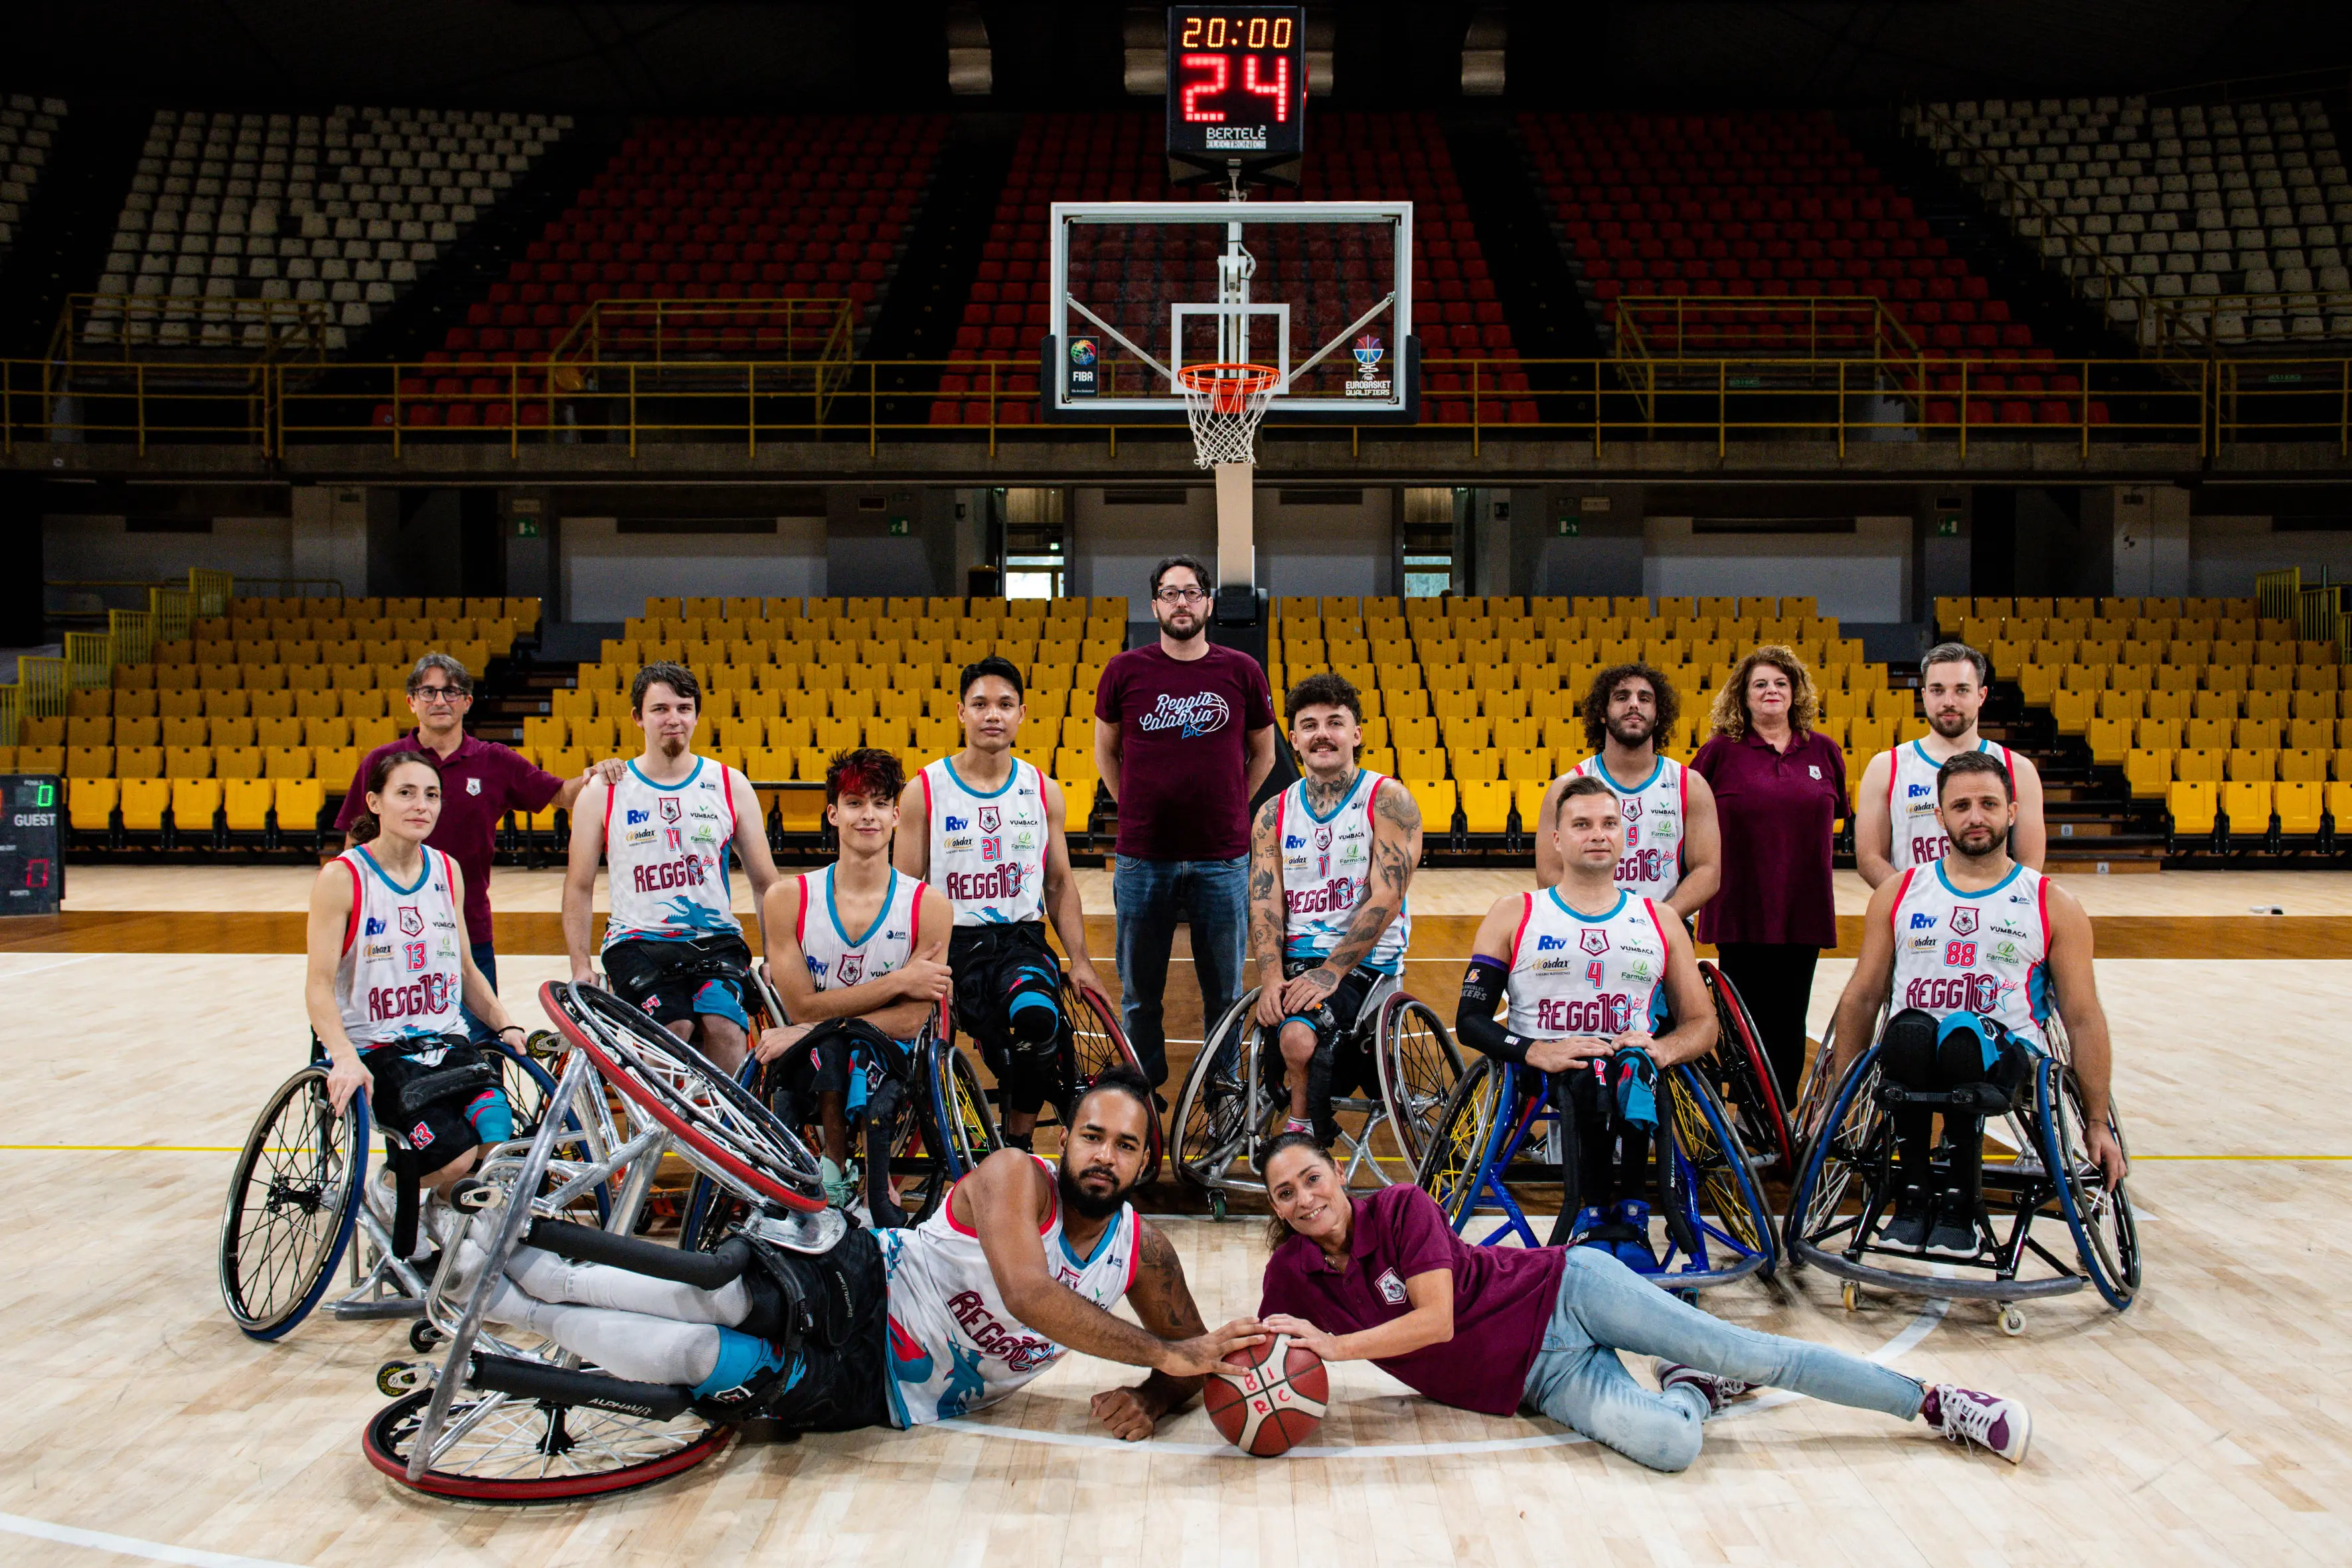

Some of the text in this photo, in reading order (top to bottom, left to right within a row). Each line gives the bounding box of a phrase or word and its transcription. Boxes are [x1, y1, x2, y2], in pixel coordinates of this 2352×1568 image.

[1183, 18, 1292, 48] 20:00
[1182, 55, 1288, 122] 24
[1073, 372, 1093, 382] FIBA
[1346, 380, 1391, 389] EUROBASKET
[1154, 691, 1212, 717] Reggio
[1140, 708, 1214, 731] Calabria
[37, 785, 54, 807] 0
[14, 813, 57, 826] GUEST
[1338, 832, 1365, 840] VUMBACA
[1626, 824, 1640, 848] 9
[980, 836, 1002, 862] 21
[1912, 836, 1950, 864] REG
[1990, 925, 2027, 939] VUMBACA
[402, 941, 428, 972] 13
[1620, 945, 1654, 956] VUMBACA
[1944, 939, 1978, 969] 88
[1986, 953, 2019, 965] FarmaciA
[1585, 960, 1605, 989] 4
[1622, 971, 1652, 983] FarmaciA
[1462, 989, 1488, 1001] KERS
[1253, 1389, 1291, 1415] R C
